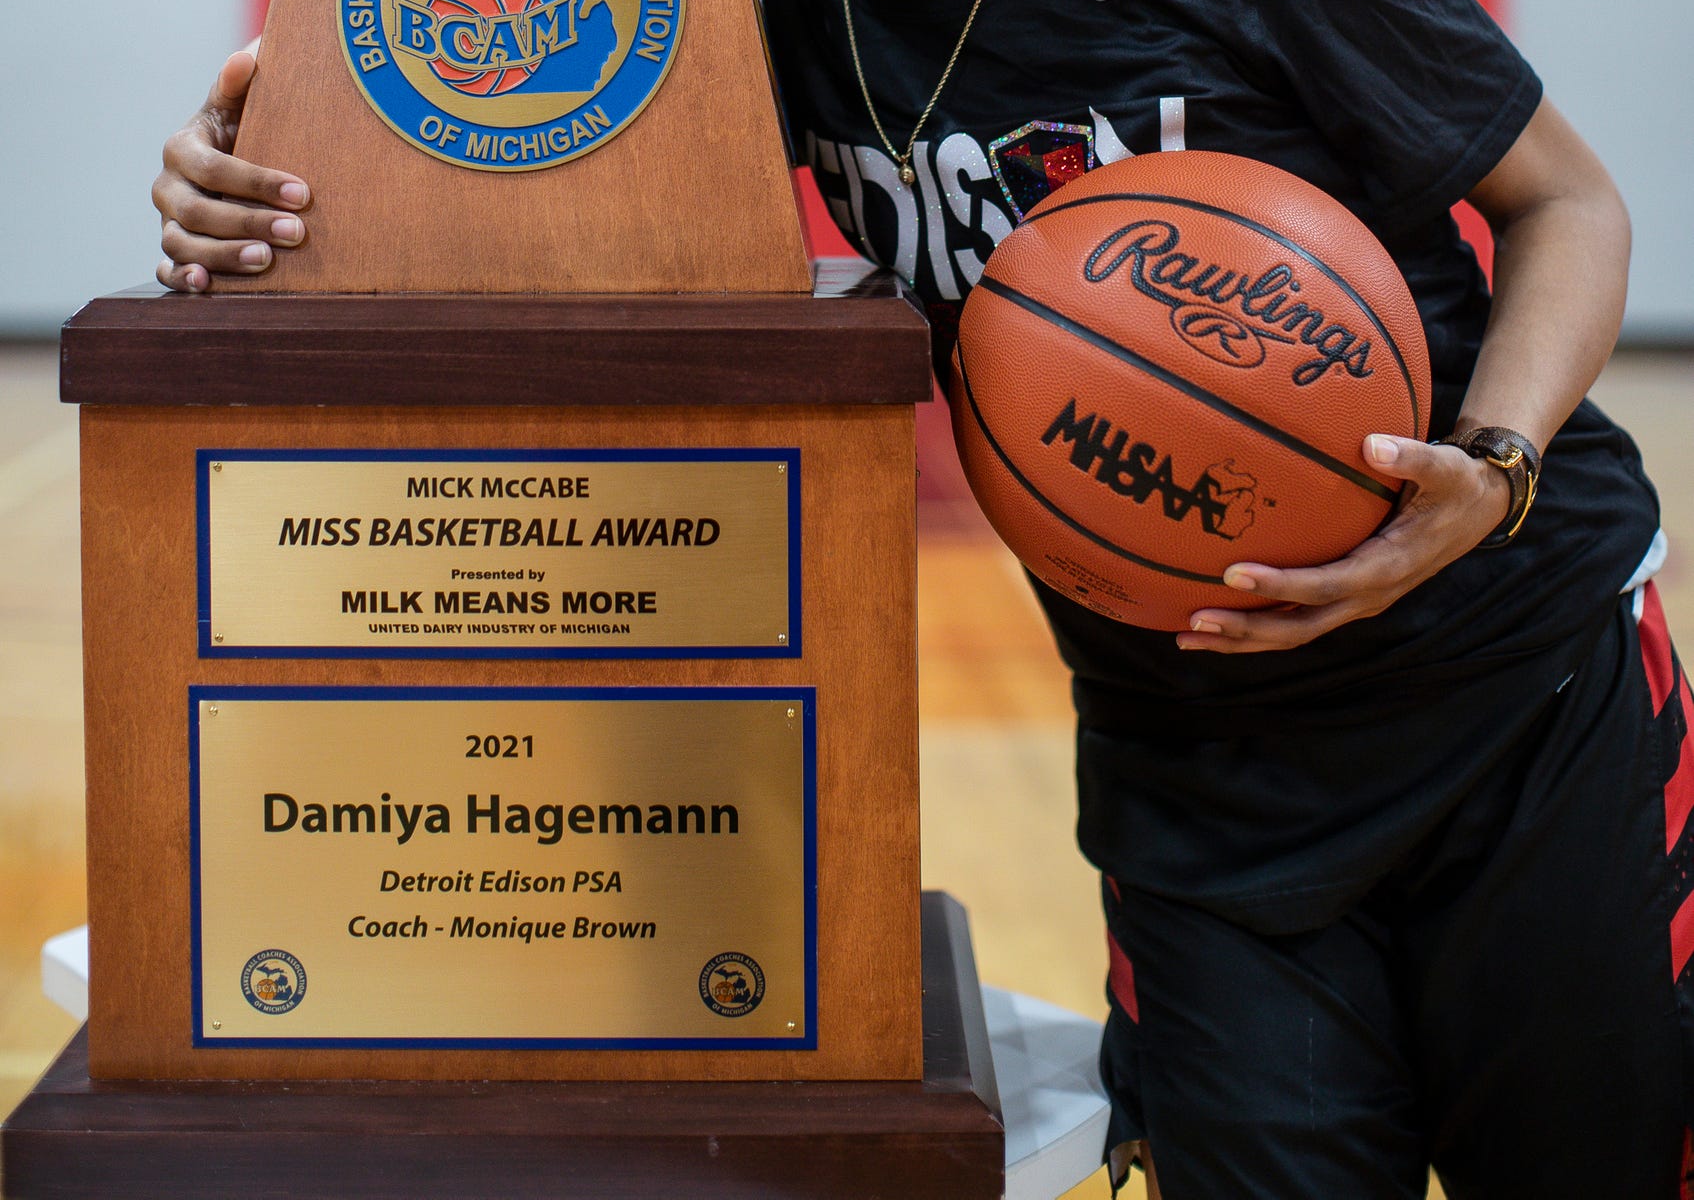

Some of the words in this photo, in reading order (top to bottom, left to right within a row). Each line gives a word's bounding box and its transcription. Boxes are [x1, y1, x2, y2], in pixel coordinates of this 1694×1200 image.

[418, 114, 463, 149] OF
[465, 104, 614, 162] MICHIGAN
[1084, 218, 1375, 387] Rawlings
[1040, 397, 1232, 542] MHSAA
[407, 477, 474, 499] MICK
[480, 476, 590, 499] McCABE
[278, 517, 362, 547] MISS
[368, 517, 584, 547] BASKETBALL
[589, 517, 721, 547] AWARD
[451, 568, 524, 580] Presented
[528, 568, 546, 583] by
[341, 591, 424, 614] MILK
[434, 591, 551, 615] MEANS
[562, 590, 658, 615] MORE
[368, 623, 420, 634] UNITED
[423, 623, 463, 634] DAIRY
[467, 623, 536, 634] INDUSTRY
[539, 623, 558, 634] OF
[560, 623, 631, 635] MICHIGAN
[465, 734, 533, 758] 2021
[264, 792, 450, 845] Damiya
[467, 794, 739, 845] Hagemann
[380, 870, 474, 893] Detroit
[479, 869, 566, 893] Edison
[572, 870, 622, 893] PSA
[348, 915, 428, 938] Coach
[449, 915, 566, 944] Monique
[572, 916, 657, 939] Brown
[257, 951, 286, 961] COACHES
[254, 1000, 263, 1009] OF
[263, 1000, 295, 1013] MICHIGAN
[721, 1002, 753, 1015] MICHIGAN
